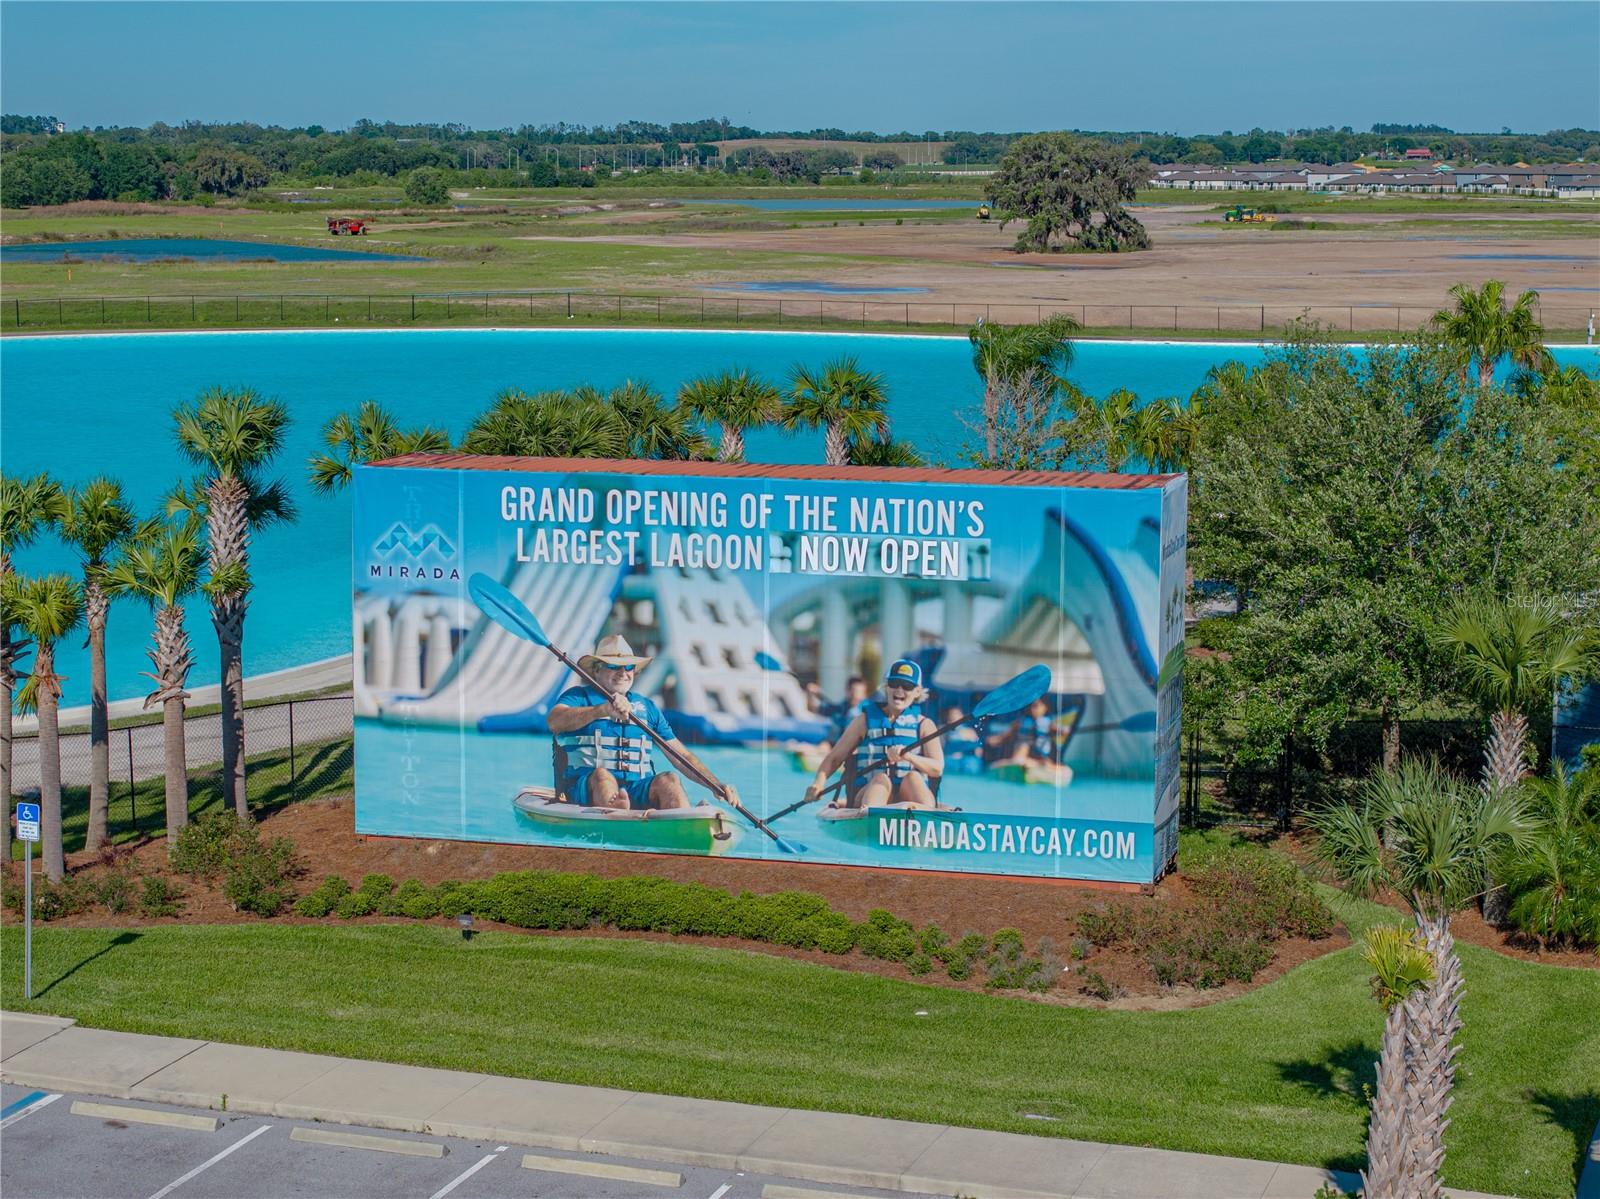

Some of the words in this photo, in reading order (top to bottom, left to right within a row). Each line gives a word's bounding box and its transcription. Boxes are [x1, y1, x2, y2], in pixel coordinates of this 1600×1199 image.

[501, 486, 594, 523] GRAND
[606, 489, 728, 528] OPENING
[740, 493, 774, 529] OF
[785, 495, 838, 531] THE
[850, 497, 985, 537] NATION'S
[370, 565, 460, 580] MIRADA
[516, 527, 640, 566] LARGEST
[651, 532, 762, 571] LAGOON
[800, 535, 869, 574] NOW
[880, 538, 960, 577] OPEN
[879, 818, 1136, 860] MIRADASTAYCAY.COM
